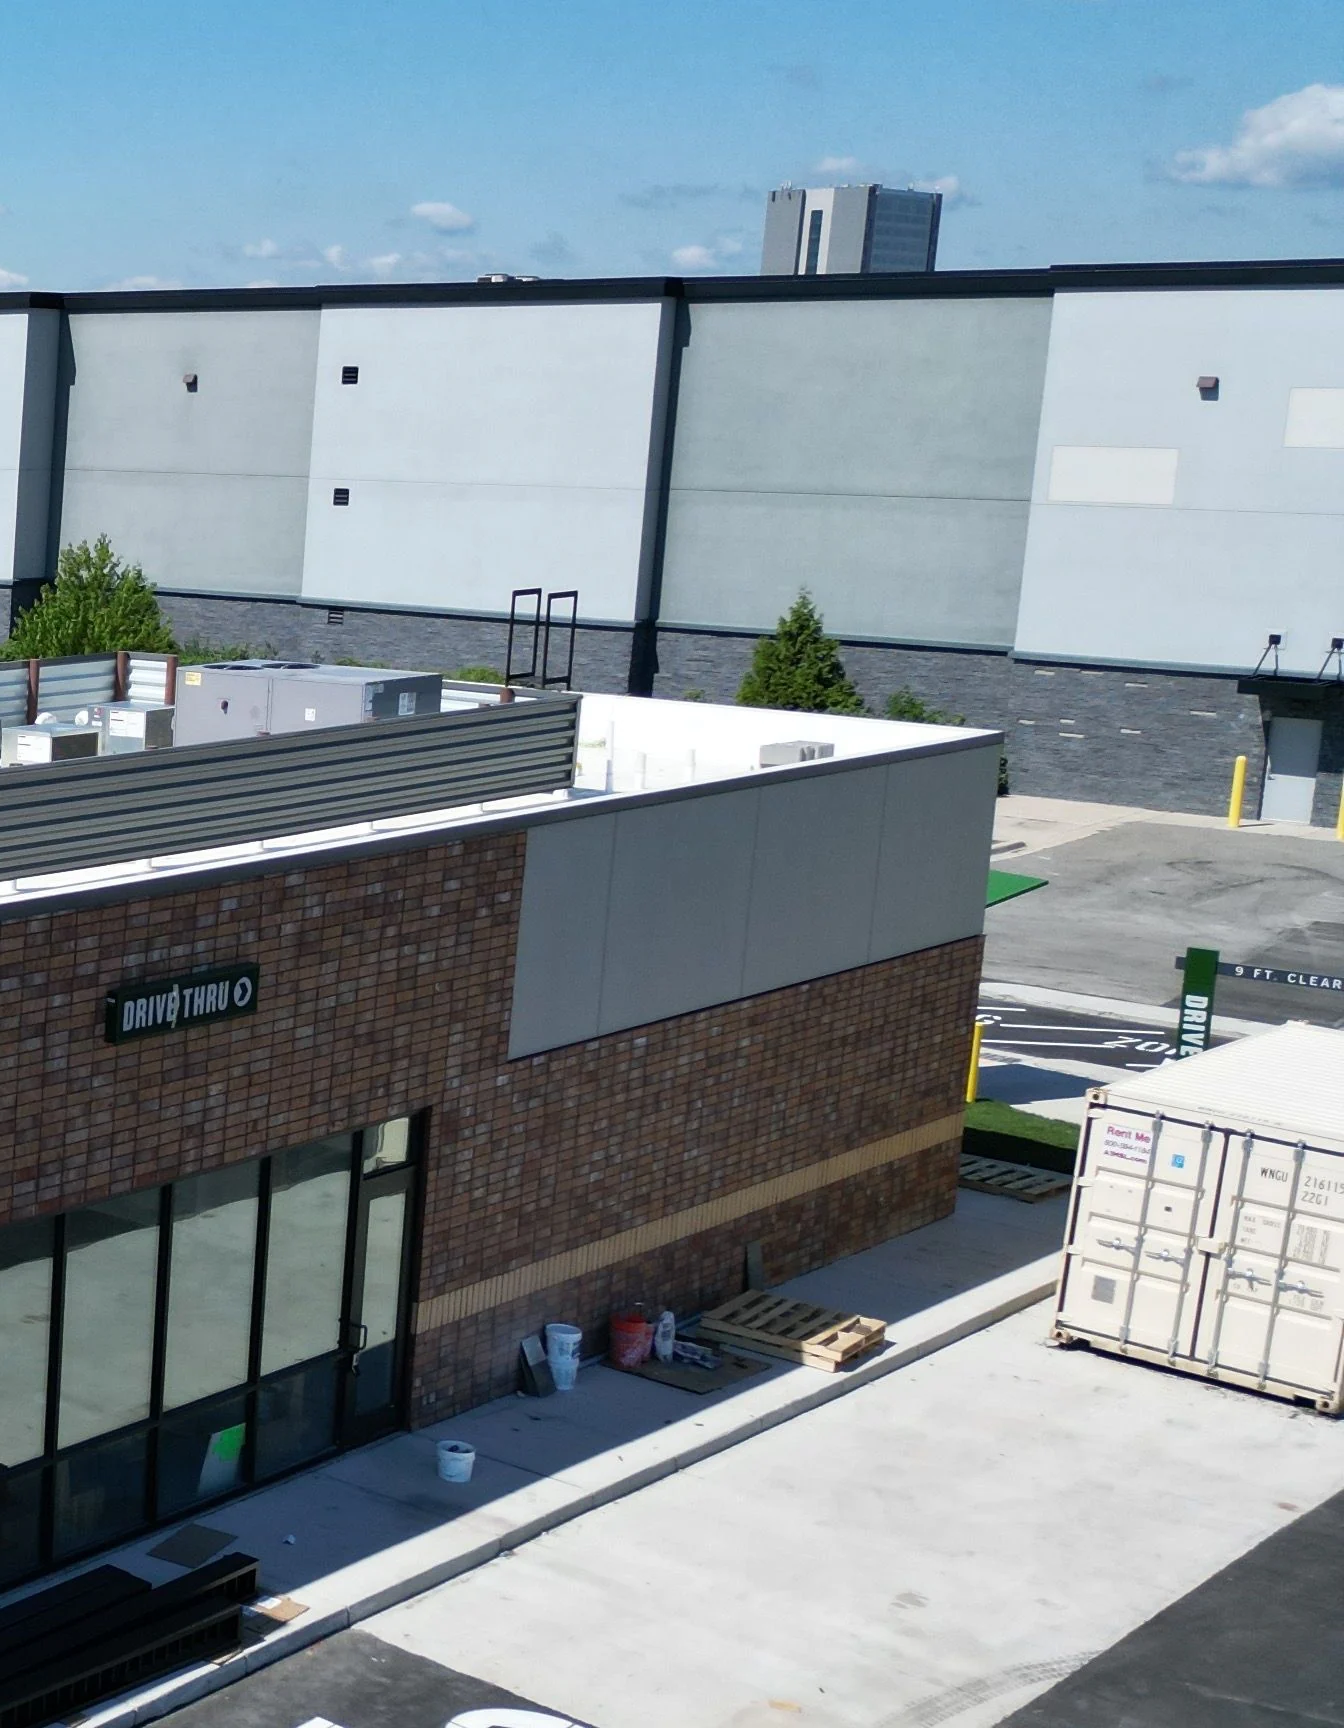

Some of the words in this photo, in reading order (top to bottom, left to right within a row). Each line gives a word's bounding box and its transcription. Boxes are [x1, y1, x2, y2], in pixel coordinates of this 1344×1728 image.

[1234, 966, 1244, 976] 9
[1287, 973, 1343, 990] CLEAR
[122, 991, 177, 1032] DRIVE
[183, 980, 230, 1019] THRU
[1260, 1167, 1289, 1182] WNGU
